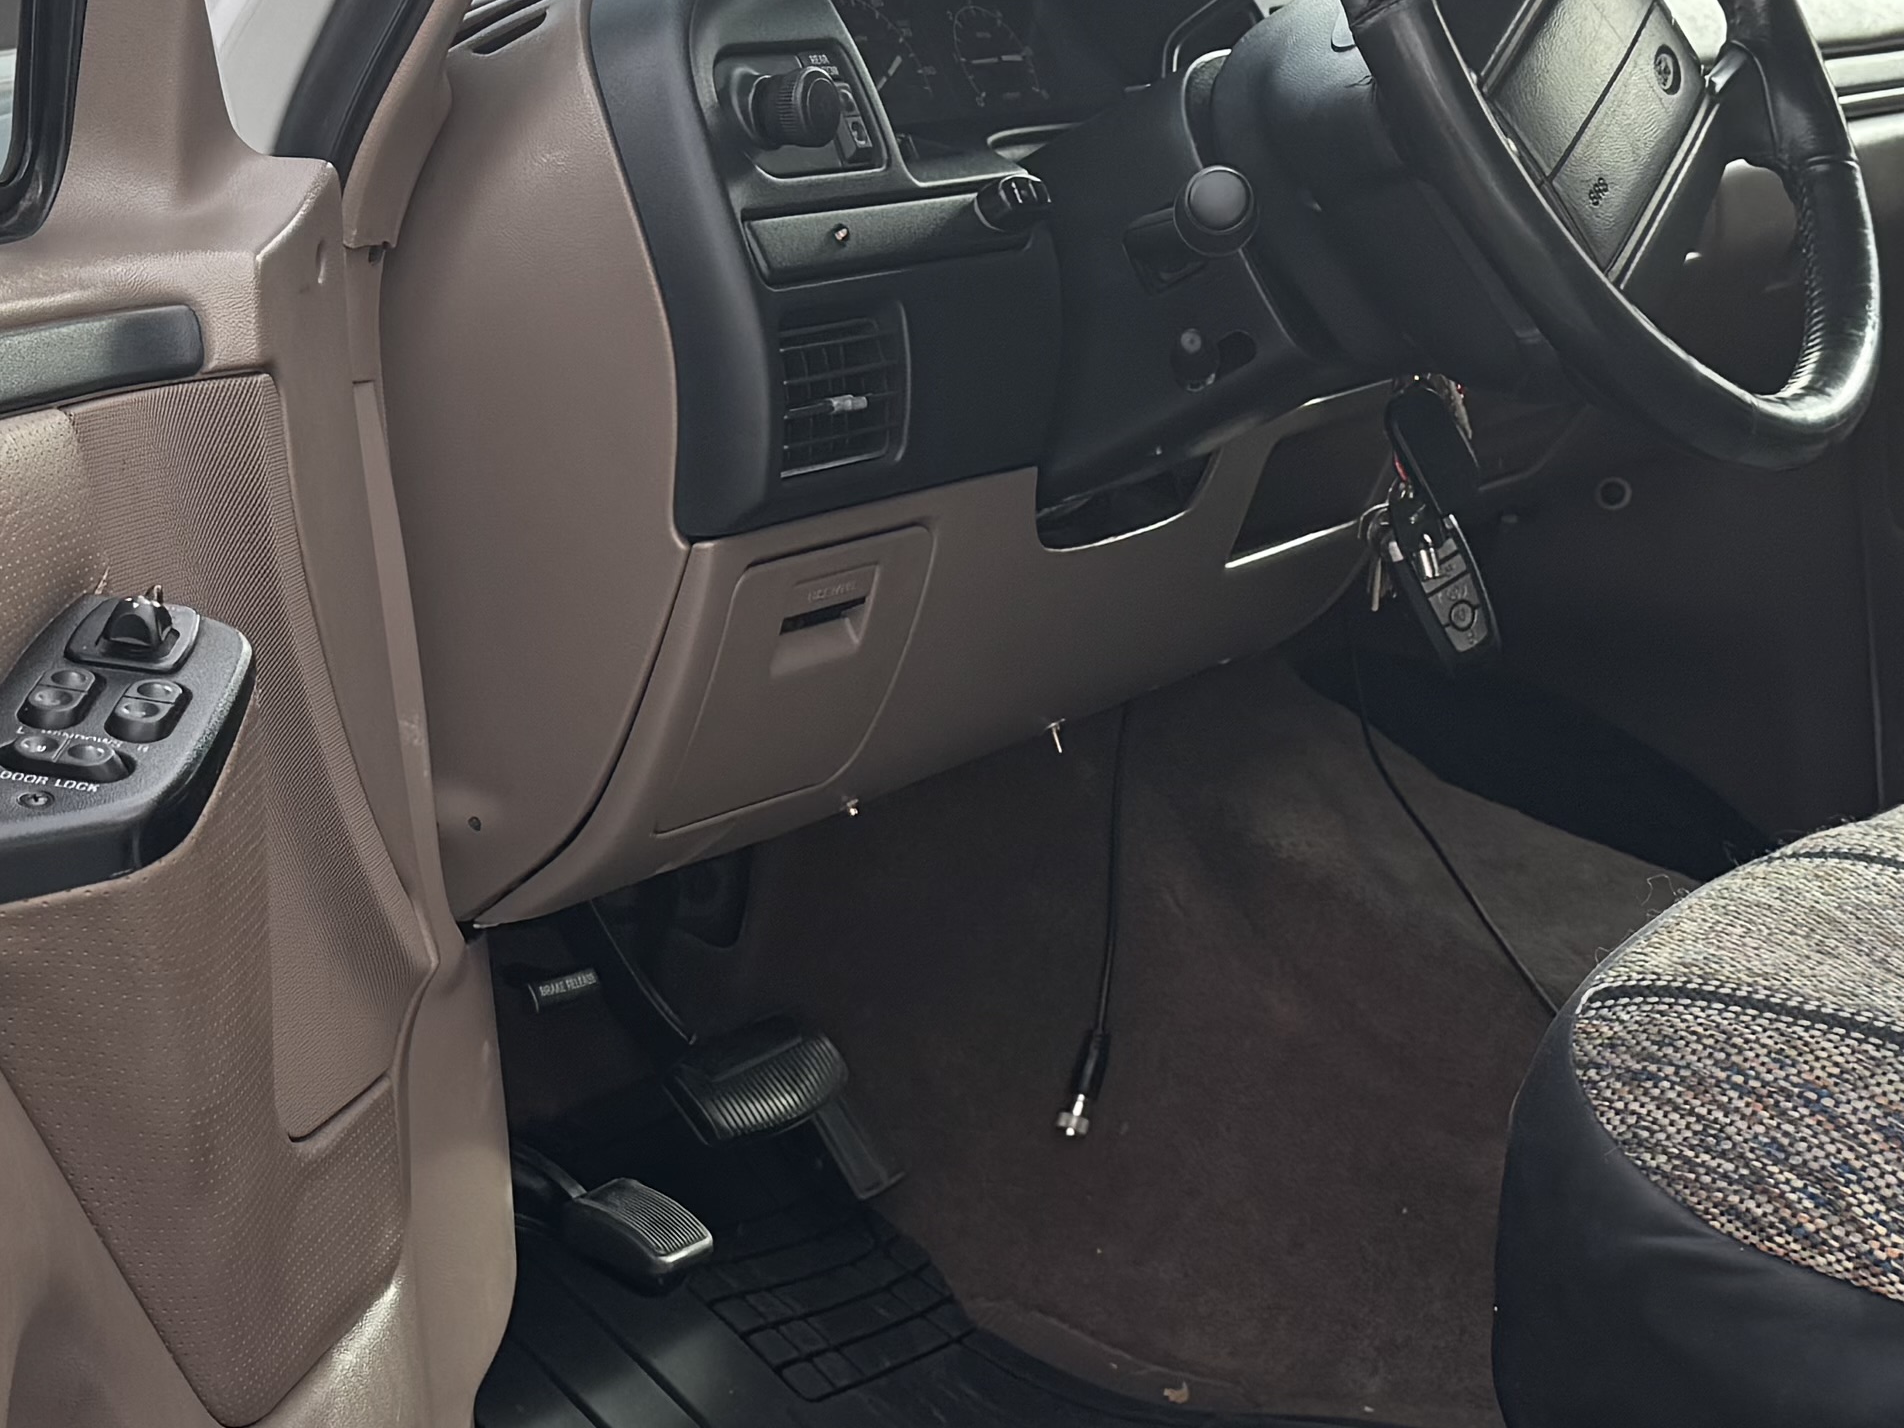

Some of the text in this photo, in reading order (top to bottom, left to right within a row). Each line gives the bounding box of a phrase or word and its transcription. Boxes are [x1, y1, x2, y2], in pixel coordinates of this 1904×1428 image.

[1588, 176, 1609, 207] SRS
[0, 770, 100, 792] DOOR LOCK
[539, 981, 566, 996] BRAKE
